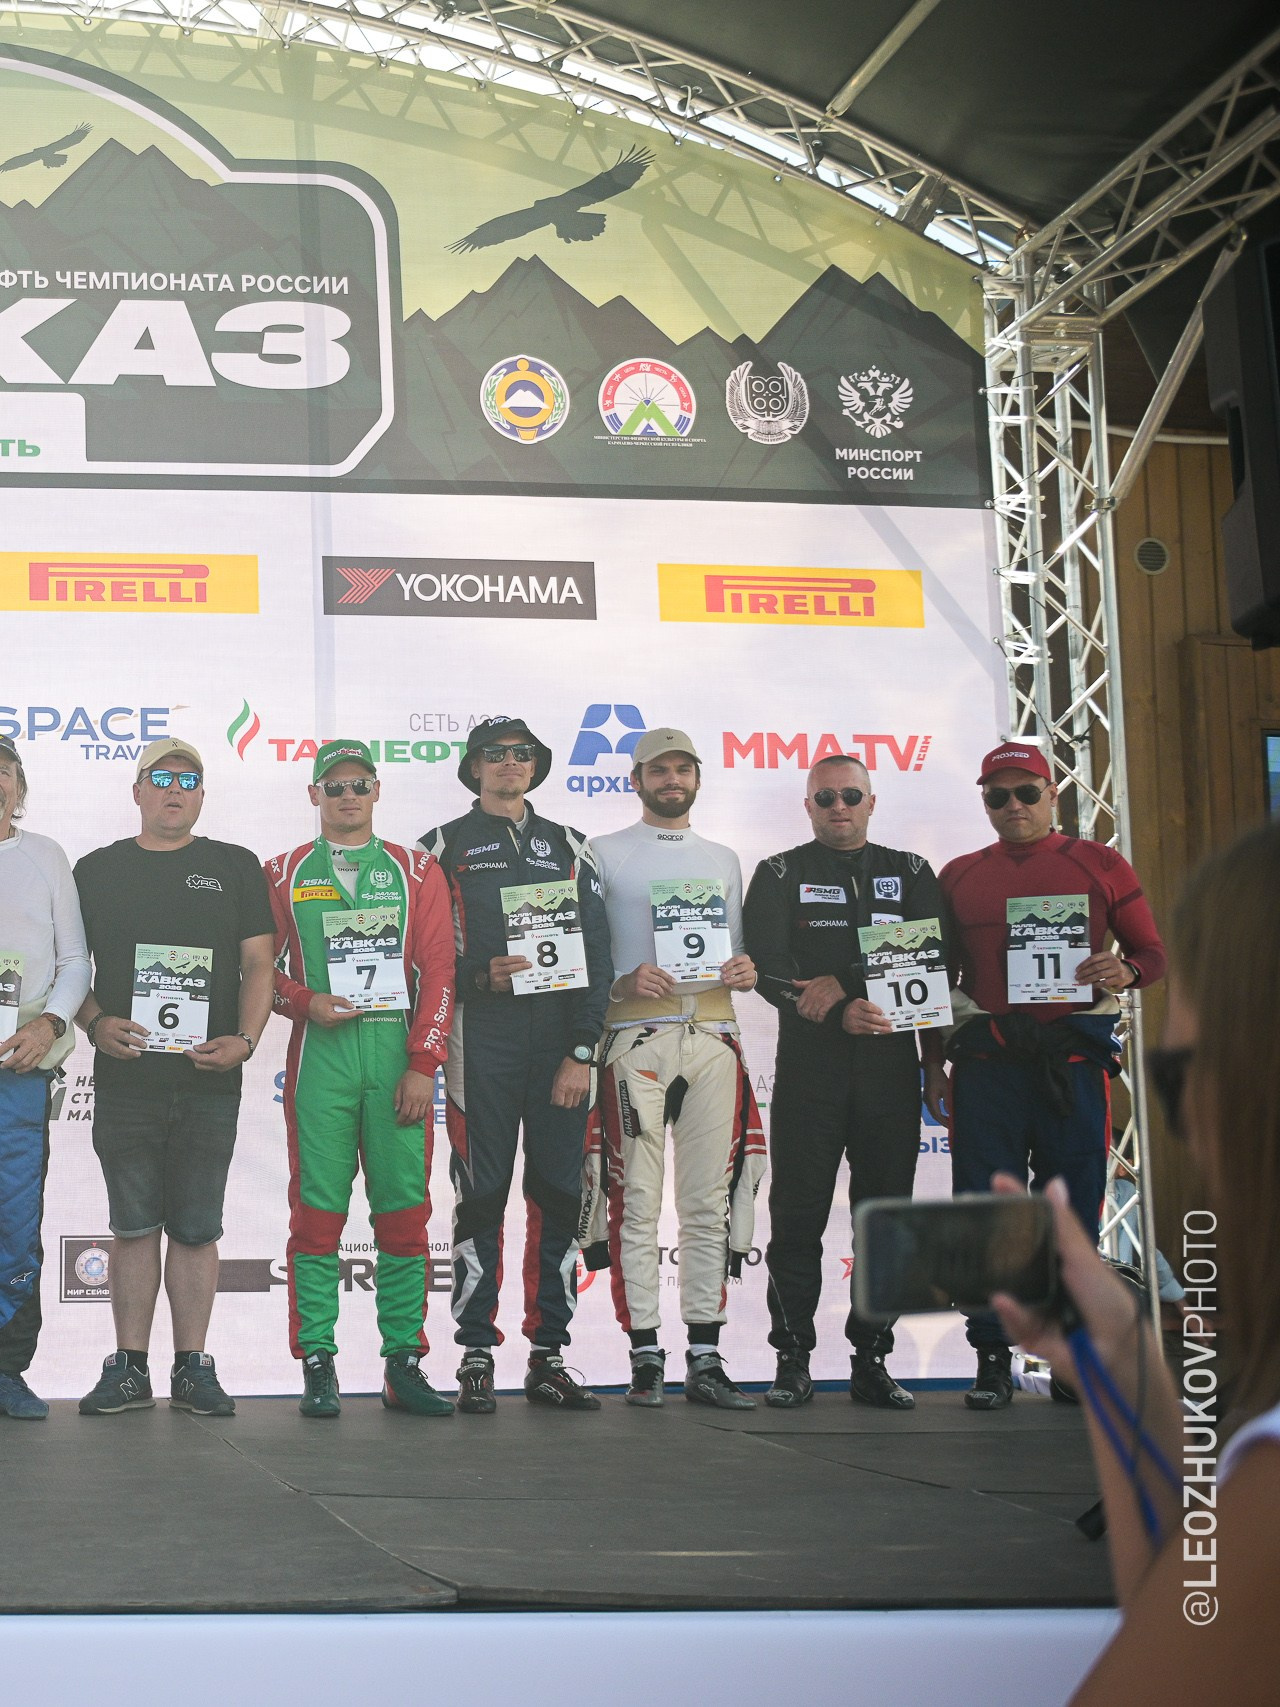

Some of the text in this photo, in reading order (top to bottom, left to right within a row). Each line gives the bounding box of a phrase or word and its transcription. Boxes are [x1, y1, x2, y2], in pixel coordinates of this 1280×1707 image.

[55, 270, 236, 294] ЧЕМПИОНАТА
[240, 272, 350, 296] РОССИИ
[835, 447, 923, 462] МИНСПОРТ
[847, 466, 914, 481] РОССИИ
[28, 561, 209, 603] PIRELLI
[396, 572, 584, 606] YOKOHAMA
[705, 574, 877, 618] PIRELLI
[409, 713, 460, 732] СЕТЬ
[80, 744, 147, 761] TRAV
[657, 833, 684, 842] sparco
[469, 862, 508, 871] YOKOHAMA
[191, 879, 217, 888] VRC
[508, 911, 577, 927] КАВКАЗ
[656, 907, 724, 919] КАВКАЗ
[808, 920, 849, 928] YOKOHAMA
[1010, 925, 1085, 937] КАВКАЗ
[330, 937, 398, 950] КАВКАЗ
[683, 933, 706, 959] 9
[536, 940, 559, 968] 8
[867, 950, 940, 967] КАВКАЗ
[1032, 953, 1061, 980] 11
[136, 974, 206, 988] КАВКАЗ
[355, 964, 377, 991] 7
[887, 978, 929, 1008] 10
[158, 1002, 180, 1030] 6
[86, 1287, 110, 1296] СЕЙФ
